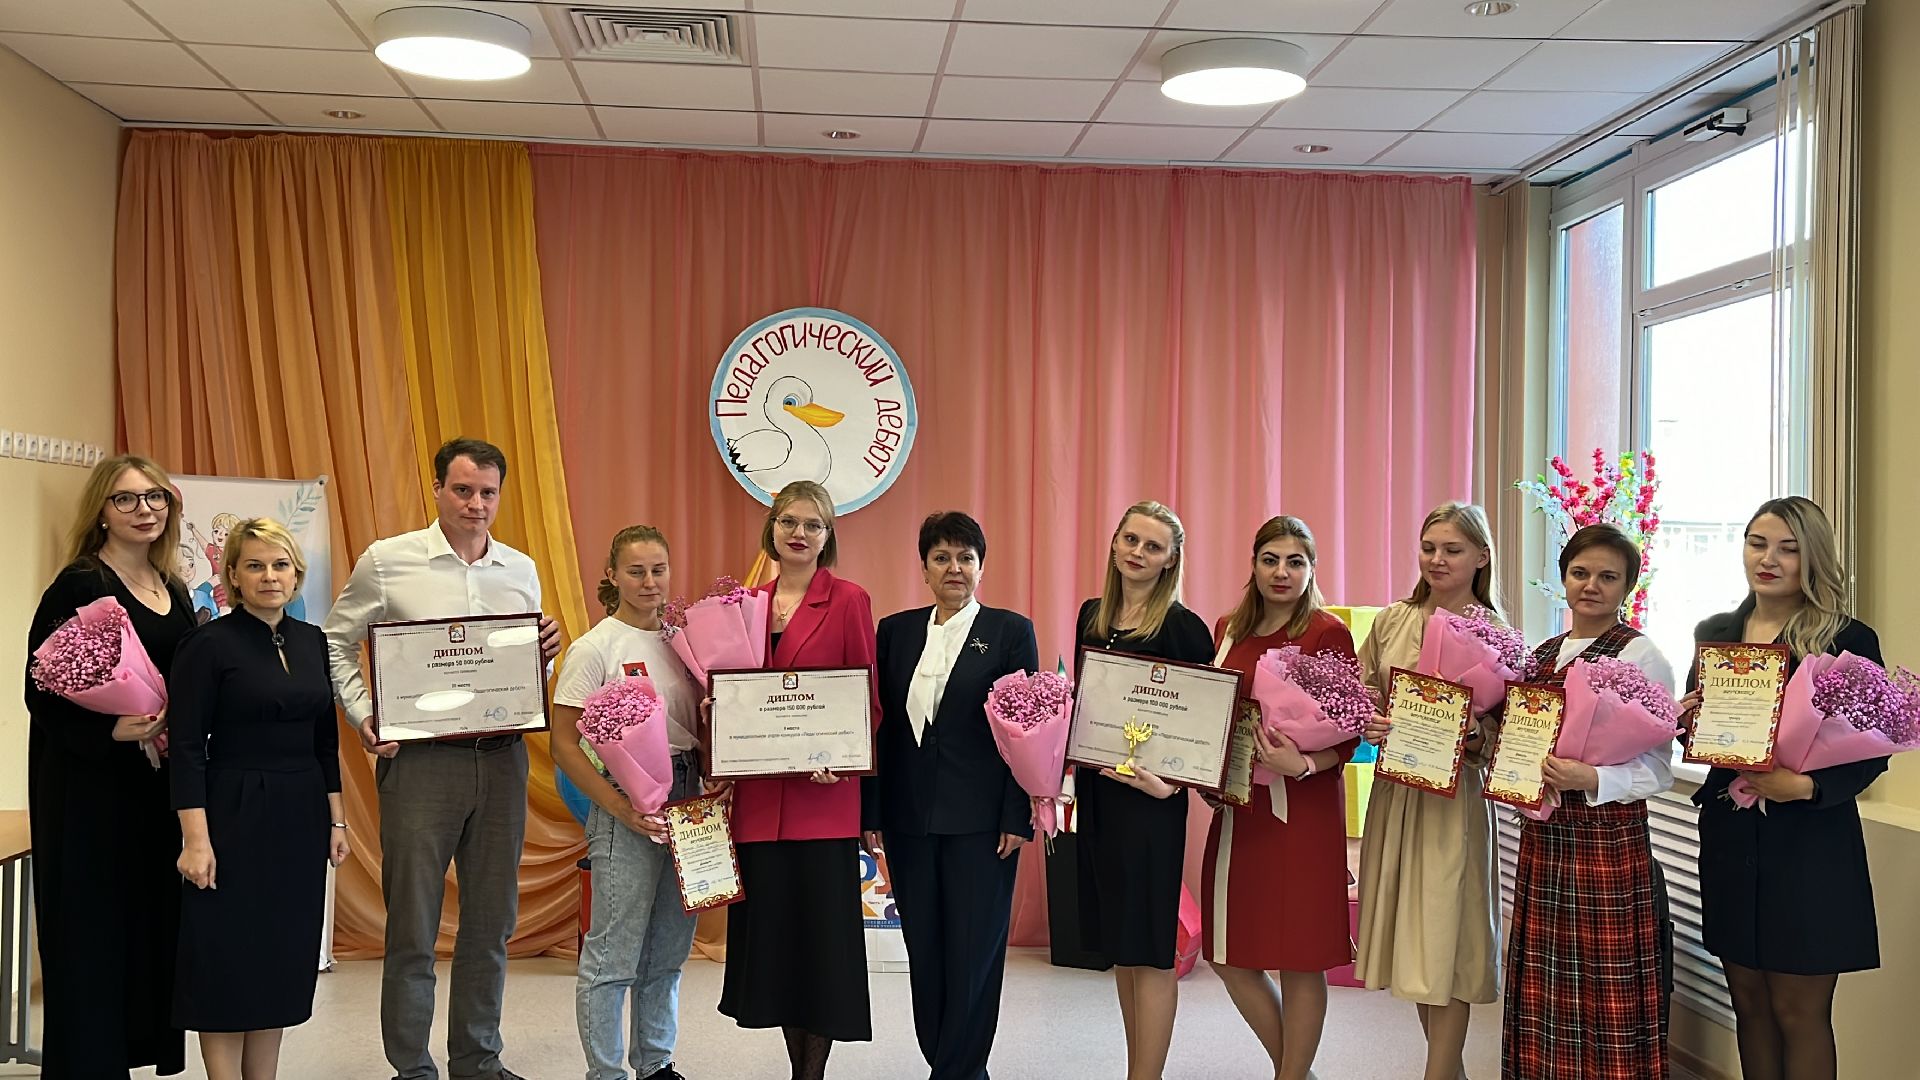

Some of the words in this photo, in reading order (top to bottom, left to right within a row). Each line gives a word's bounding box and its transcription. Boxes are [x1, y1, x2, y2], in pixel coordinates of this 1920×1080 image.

[715, 322, 895, 417] Педагогический
[433, 646, 484, 660] ДИПЛОМ
[1709, 677, 1771, 689] ДИПЛОМ
[766, 693, 815, 704] ДИПЛОМ
[1131, 684, 1180, 700] ДИПЛОМ
[1399, 699, 1455, 722] ДИПЛОМ
[1509, 714, 1551, 730] ДИПЛОМ
[679, 823, 722, 842] ДИПЛОМ
